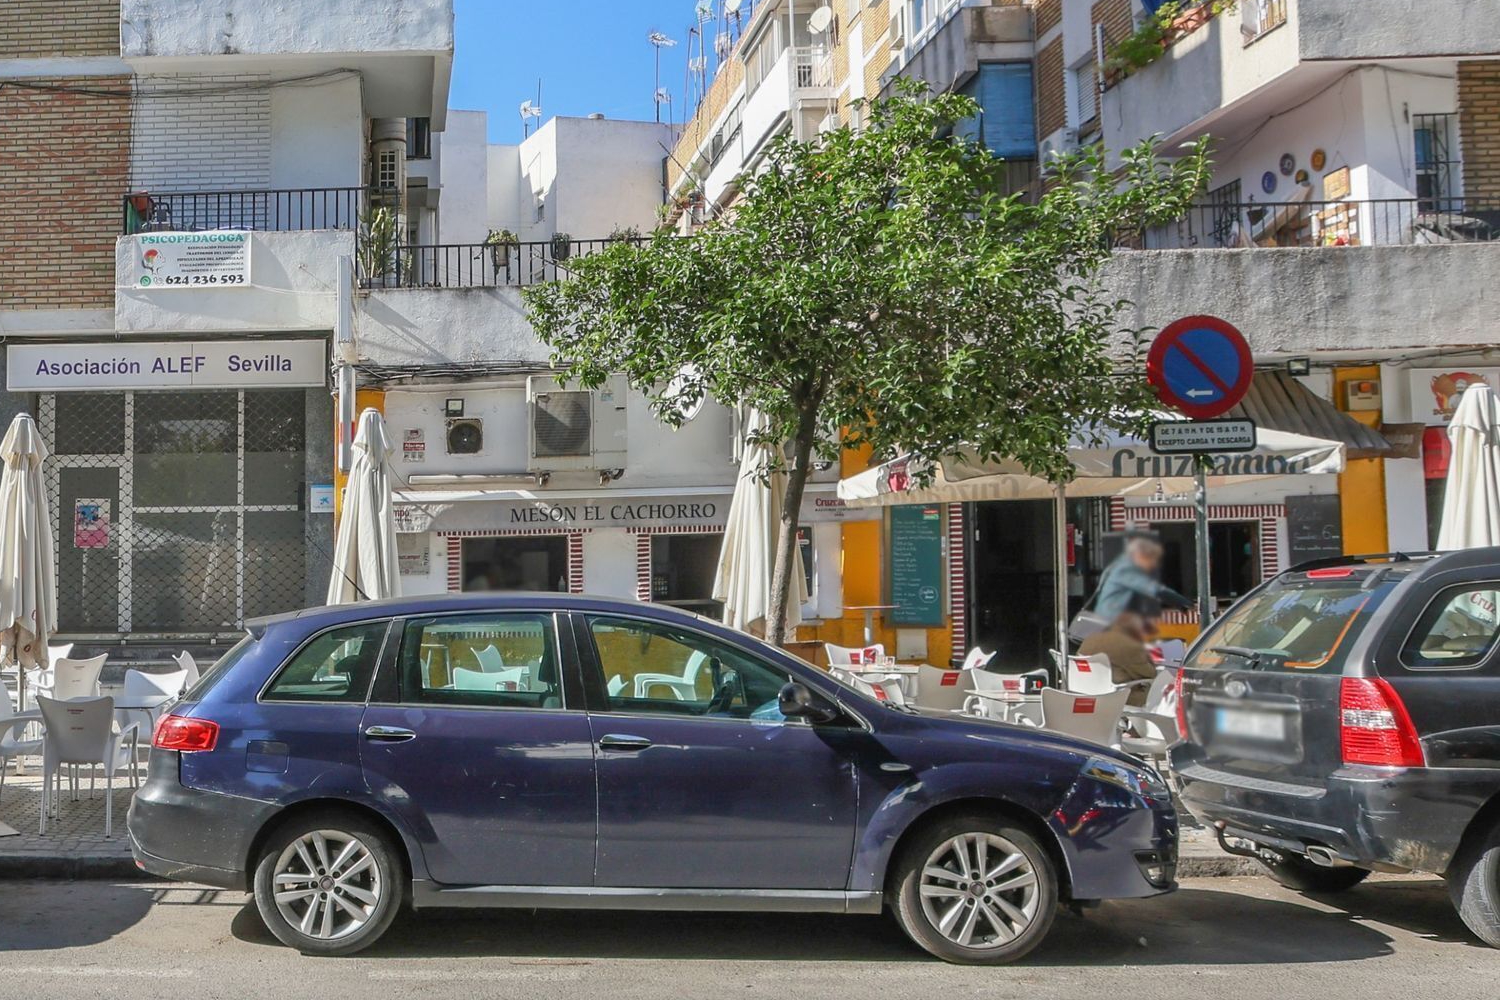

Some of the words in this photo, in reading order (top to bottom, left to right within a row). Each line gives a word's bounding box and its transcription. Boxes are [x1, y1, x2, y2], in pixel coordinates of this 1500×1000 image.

[141, 233, 244, 244] PSICOPEDAGOGA
[165, 275, 190, 285] 624
[193, 275, 217, 285] 236
[220, 274, 244, 284] 593
[36, 357, 140, 376] Asociación
[151, 356, 206, 374] ALEF
[228, 354, 293, 372] Sevilla
[1217, 436, 1251, 444] DESCARGA
[510, 503, 577, 523] MESÓN
[584, 505, 605, 521] EL
[610, 502, 716, 520] CACHORRO
